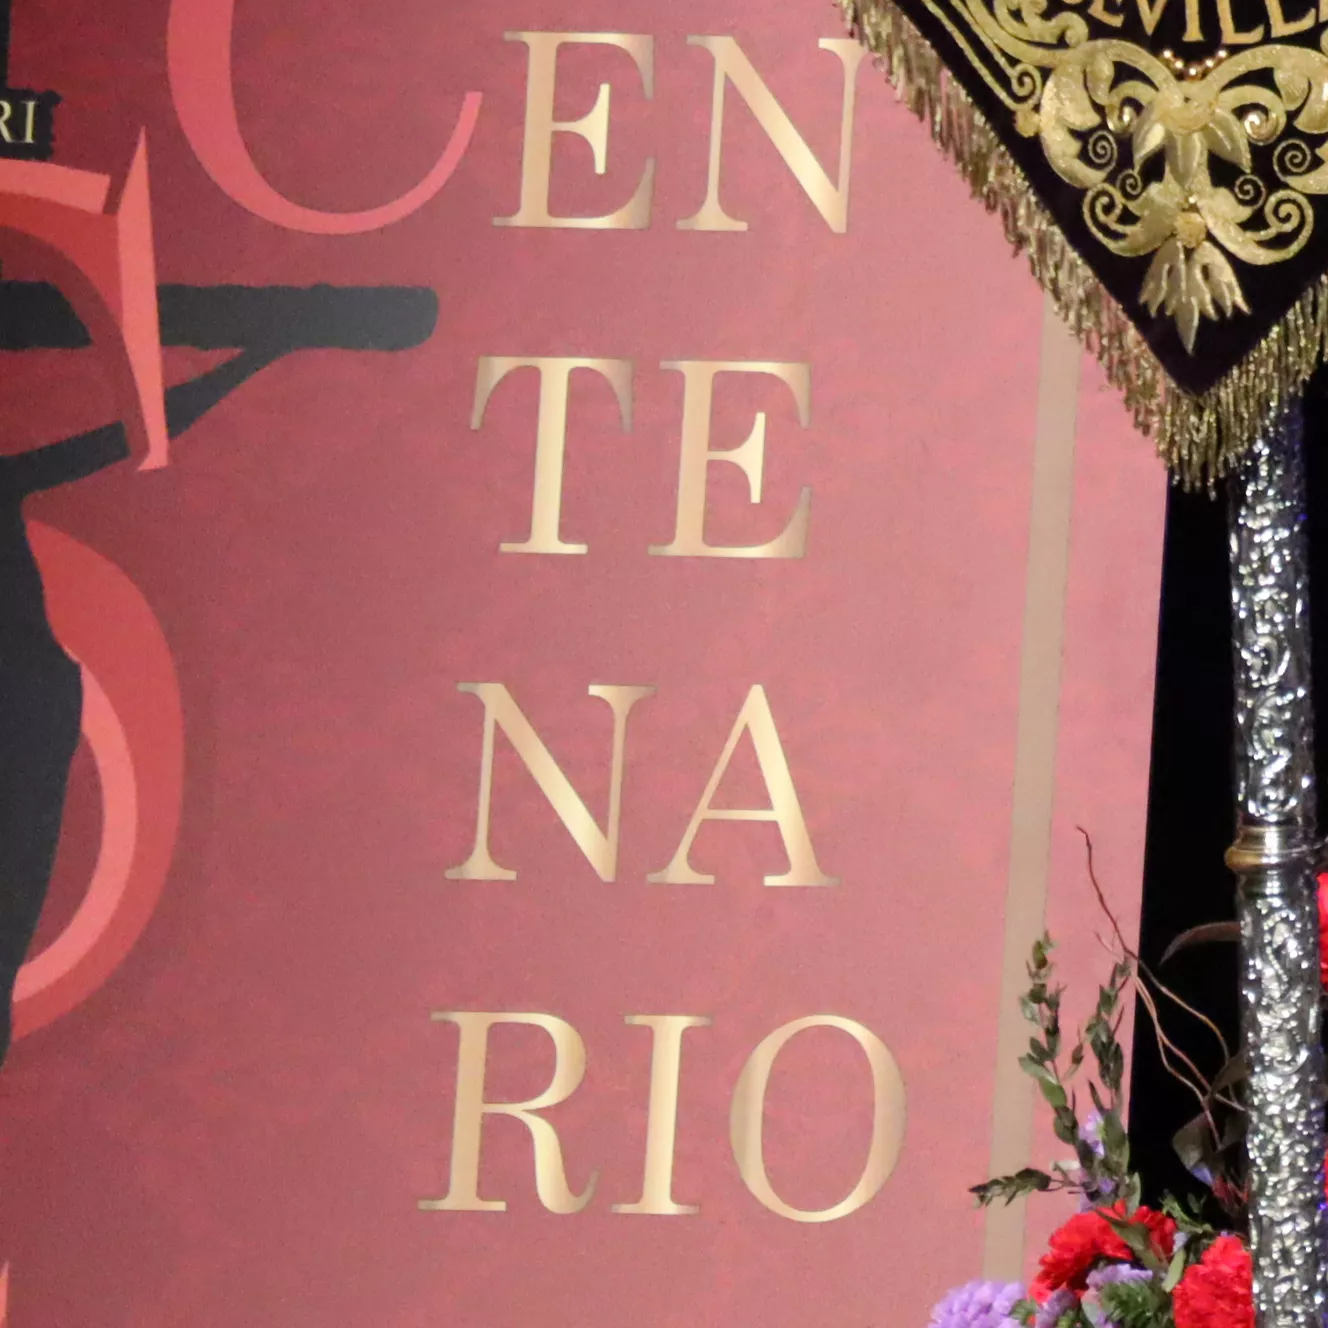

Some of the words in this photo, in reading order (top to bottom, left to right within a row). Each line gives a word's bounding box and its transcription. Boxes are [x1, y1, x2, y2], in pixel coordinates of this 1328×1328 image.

[469, 355, 811, 559] TE
[444, 681, 841, 888] NA
[416, 1008, 908, 1223] RIO
